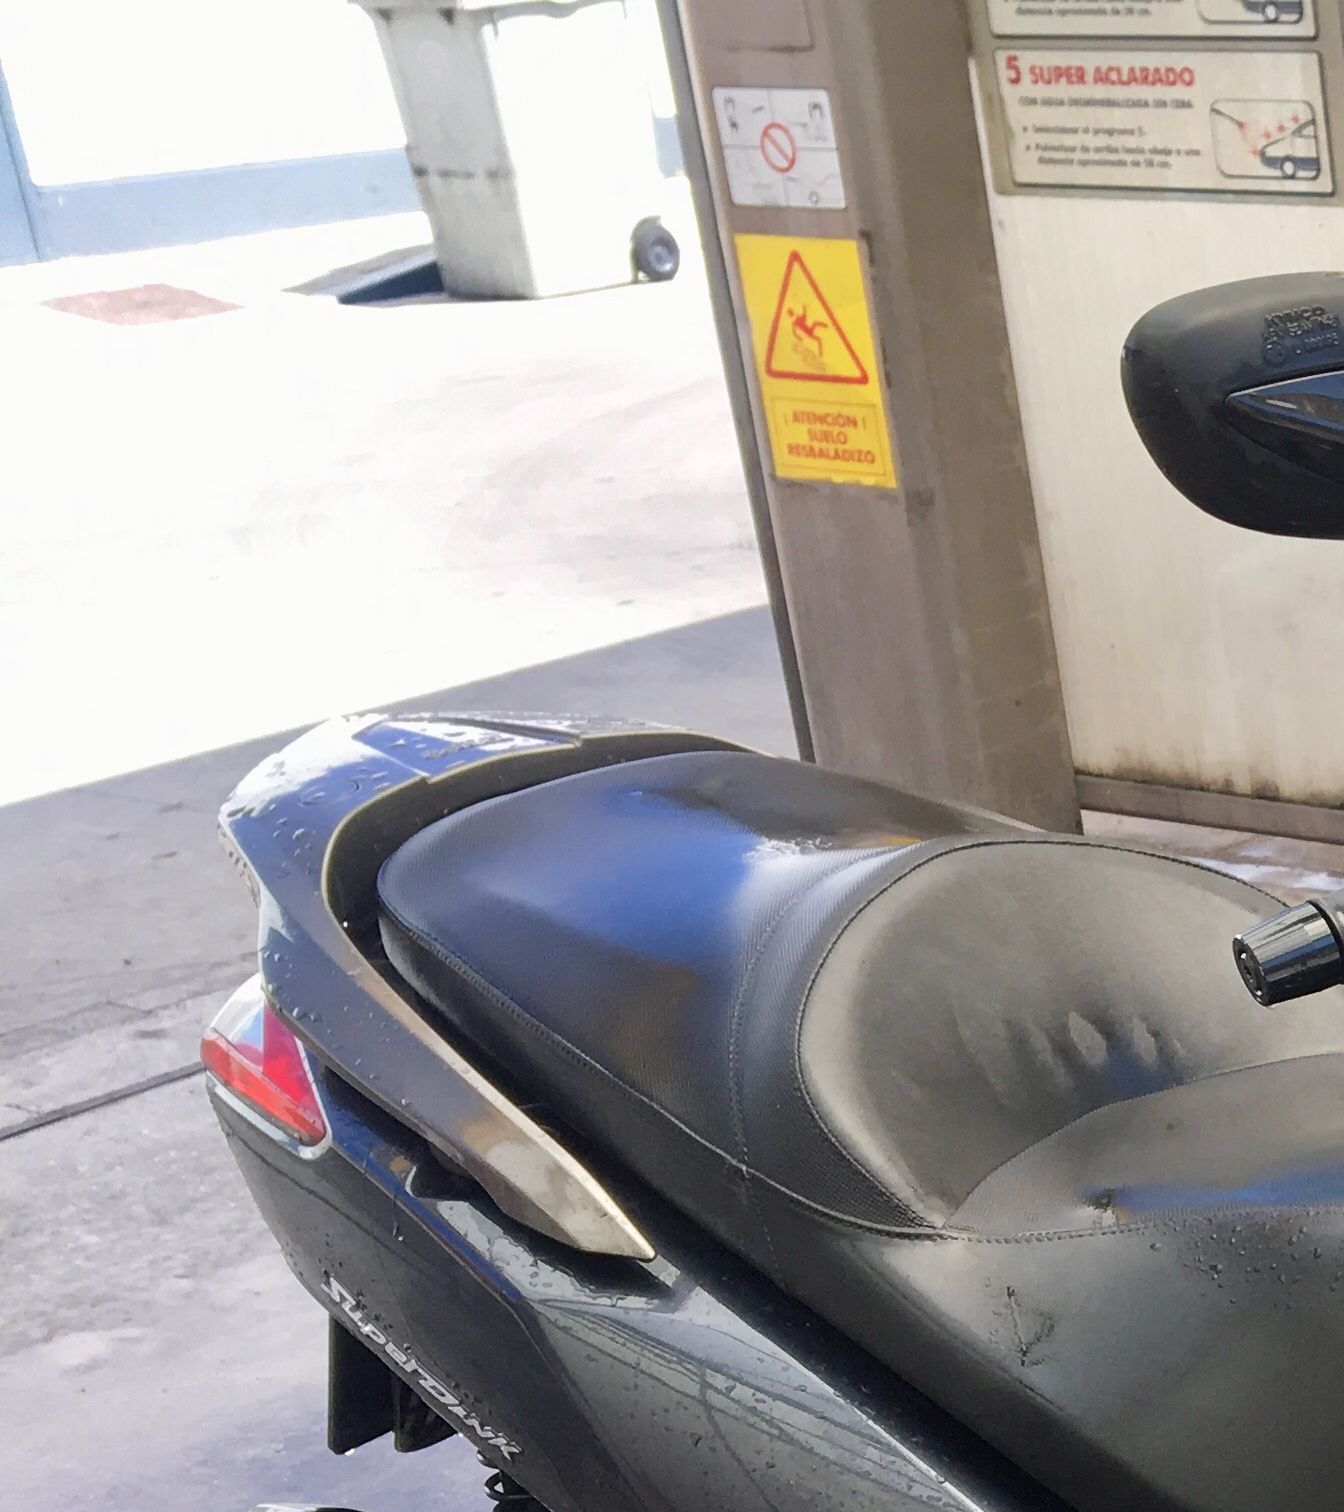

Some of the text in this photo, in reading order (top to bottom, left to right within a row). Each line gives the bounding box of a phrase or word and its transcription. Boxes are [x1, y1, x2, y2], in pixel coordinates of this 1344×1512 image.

[1006, 55, 1195, 86] 5 SUPER ACLARADO
[808, 428, 847, 445] SUELO
[787, 443, 875, 464] RESBALADIZO
